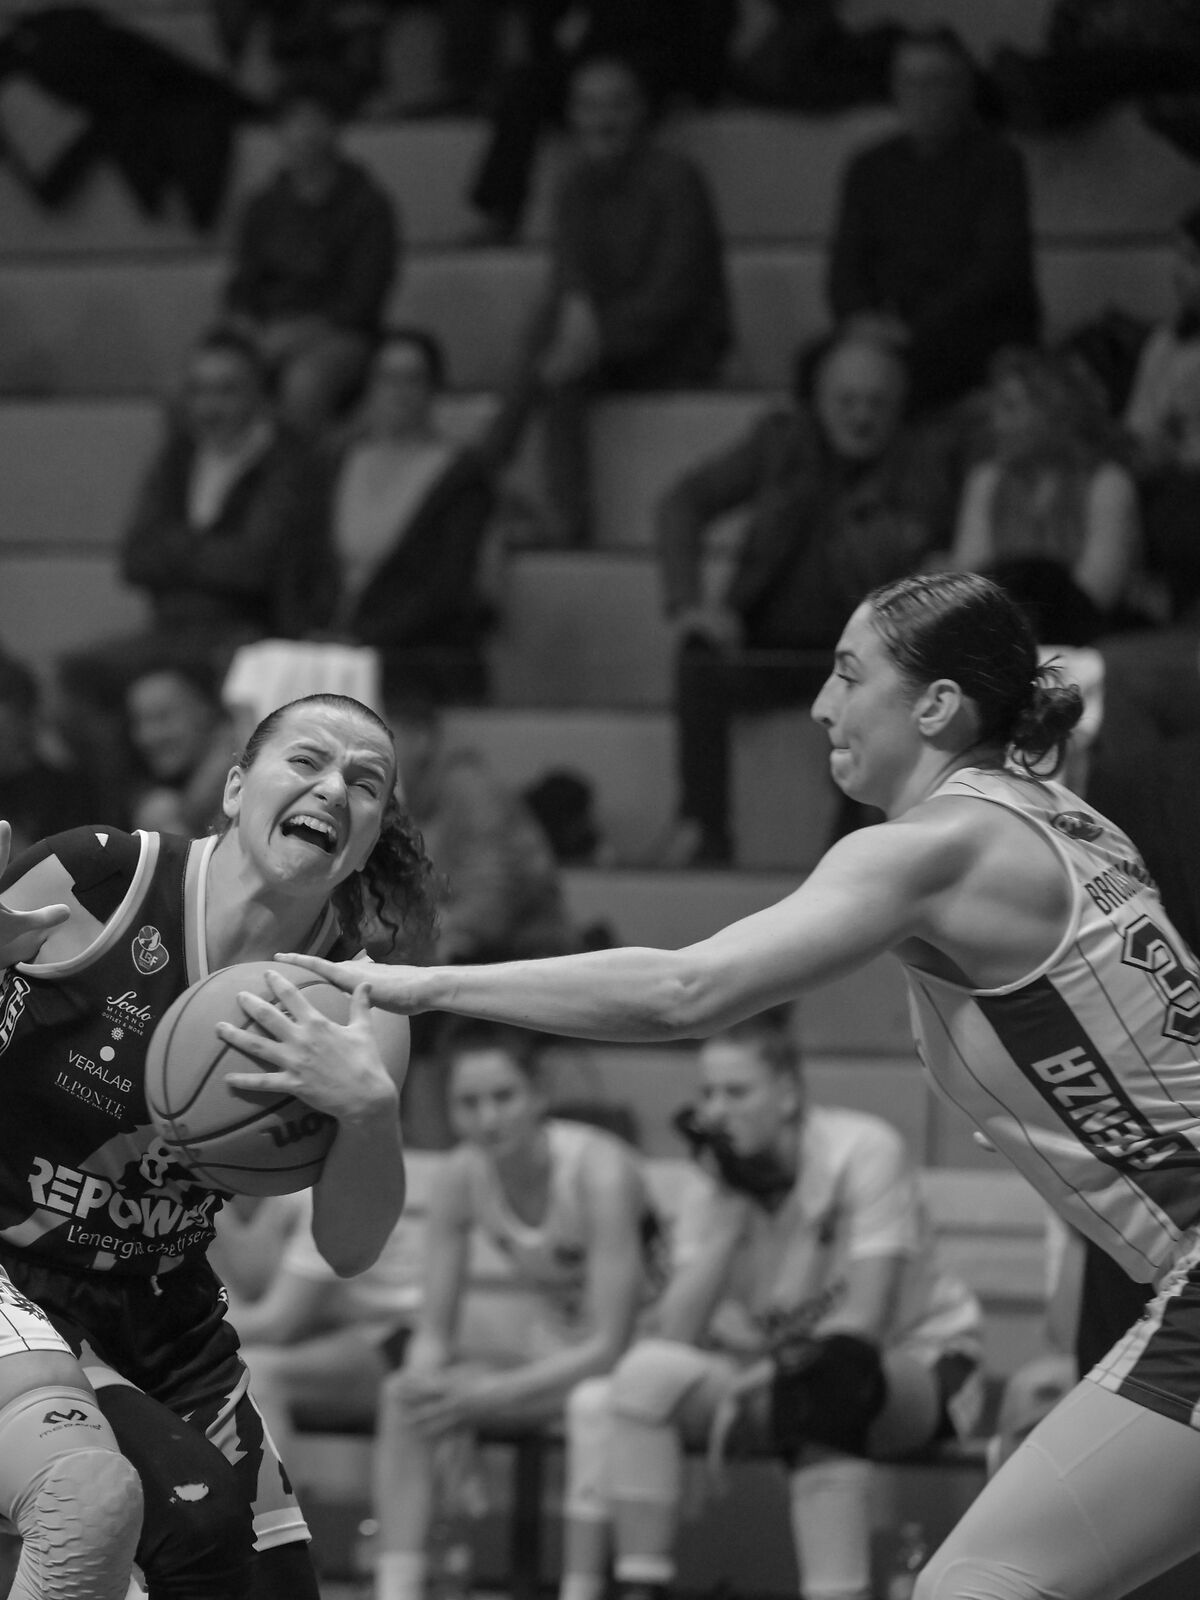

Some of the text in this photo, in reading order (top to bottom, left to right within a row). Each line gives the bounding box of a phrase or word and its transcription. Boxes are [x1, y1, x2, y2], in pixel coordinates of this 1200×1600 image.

[106, 990, 152, 1021] Scalo
[106, 1005, 145, 1028] MILANO
[68, 1050, 133, 1093] VERALAB
